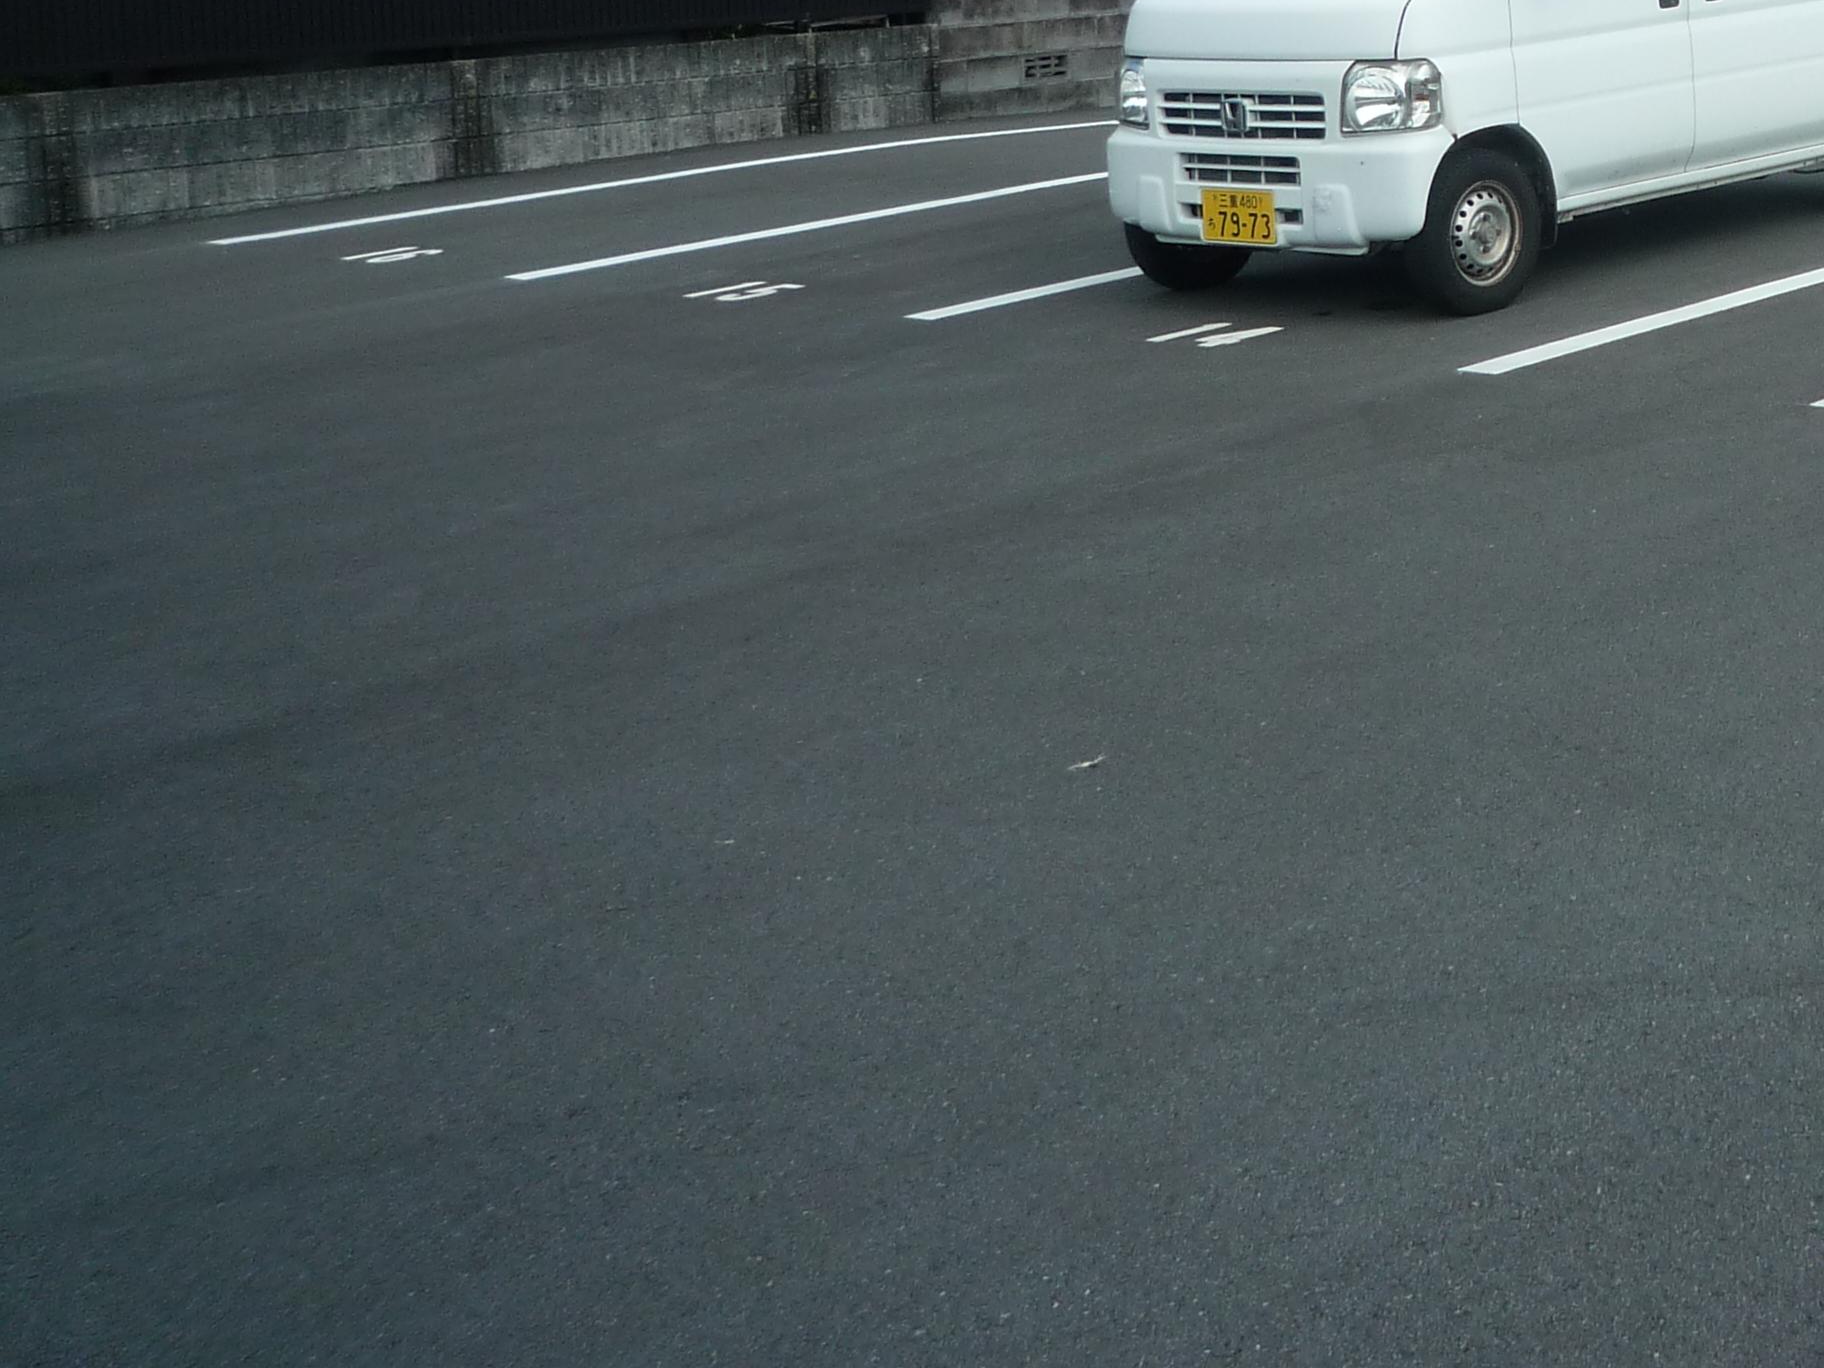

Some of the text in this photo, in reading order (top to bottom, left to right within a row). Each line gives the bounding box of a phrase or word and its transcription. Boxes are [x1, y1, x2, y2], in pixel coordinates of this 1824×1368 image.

[1218, 210, 1272, 240] 79-73
[681, 280, 807, 302] 15
[1144, 321, 1286, 348] 14
